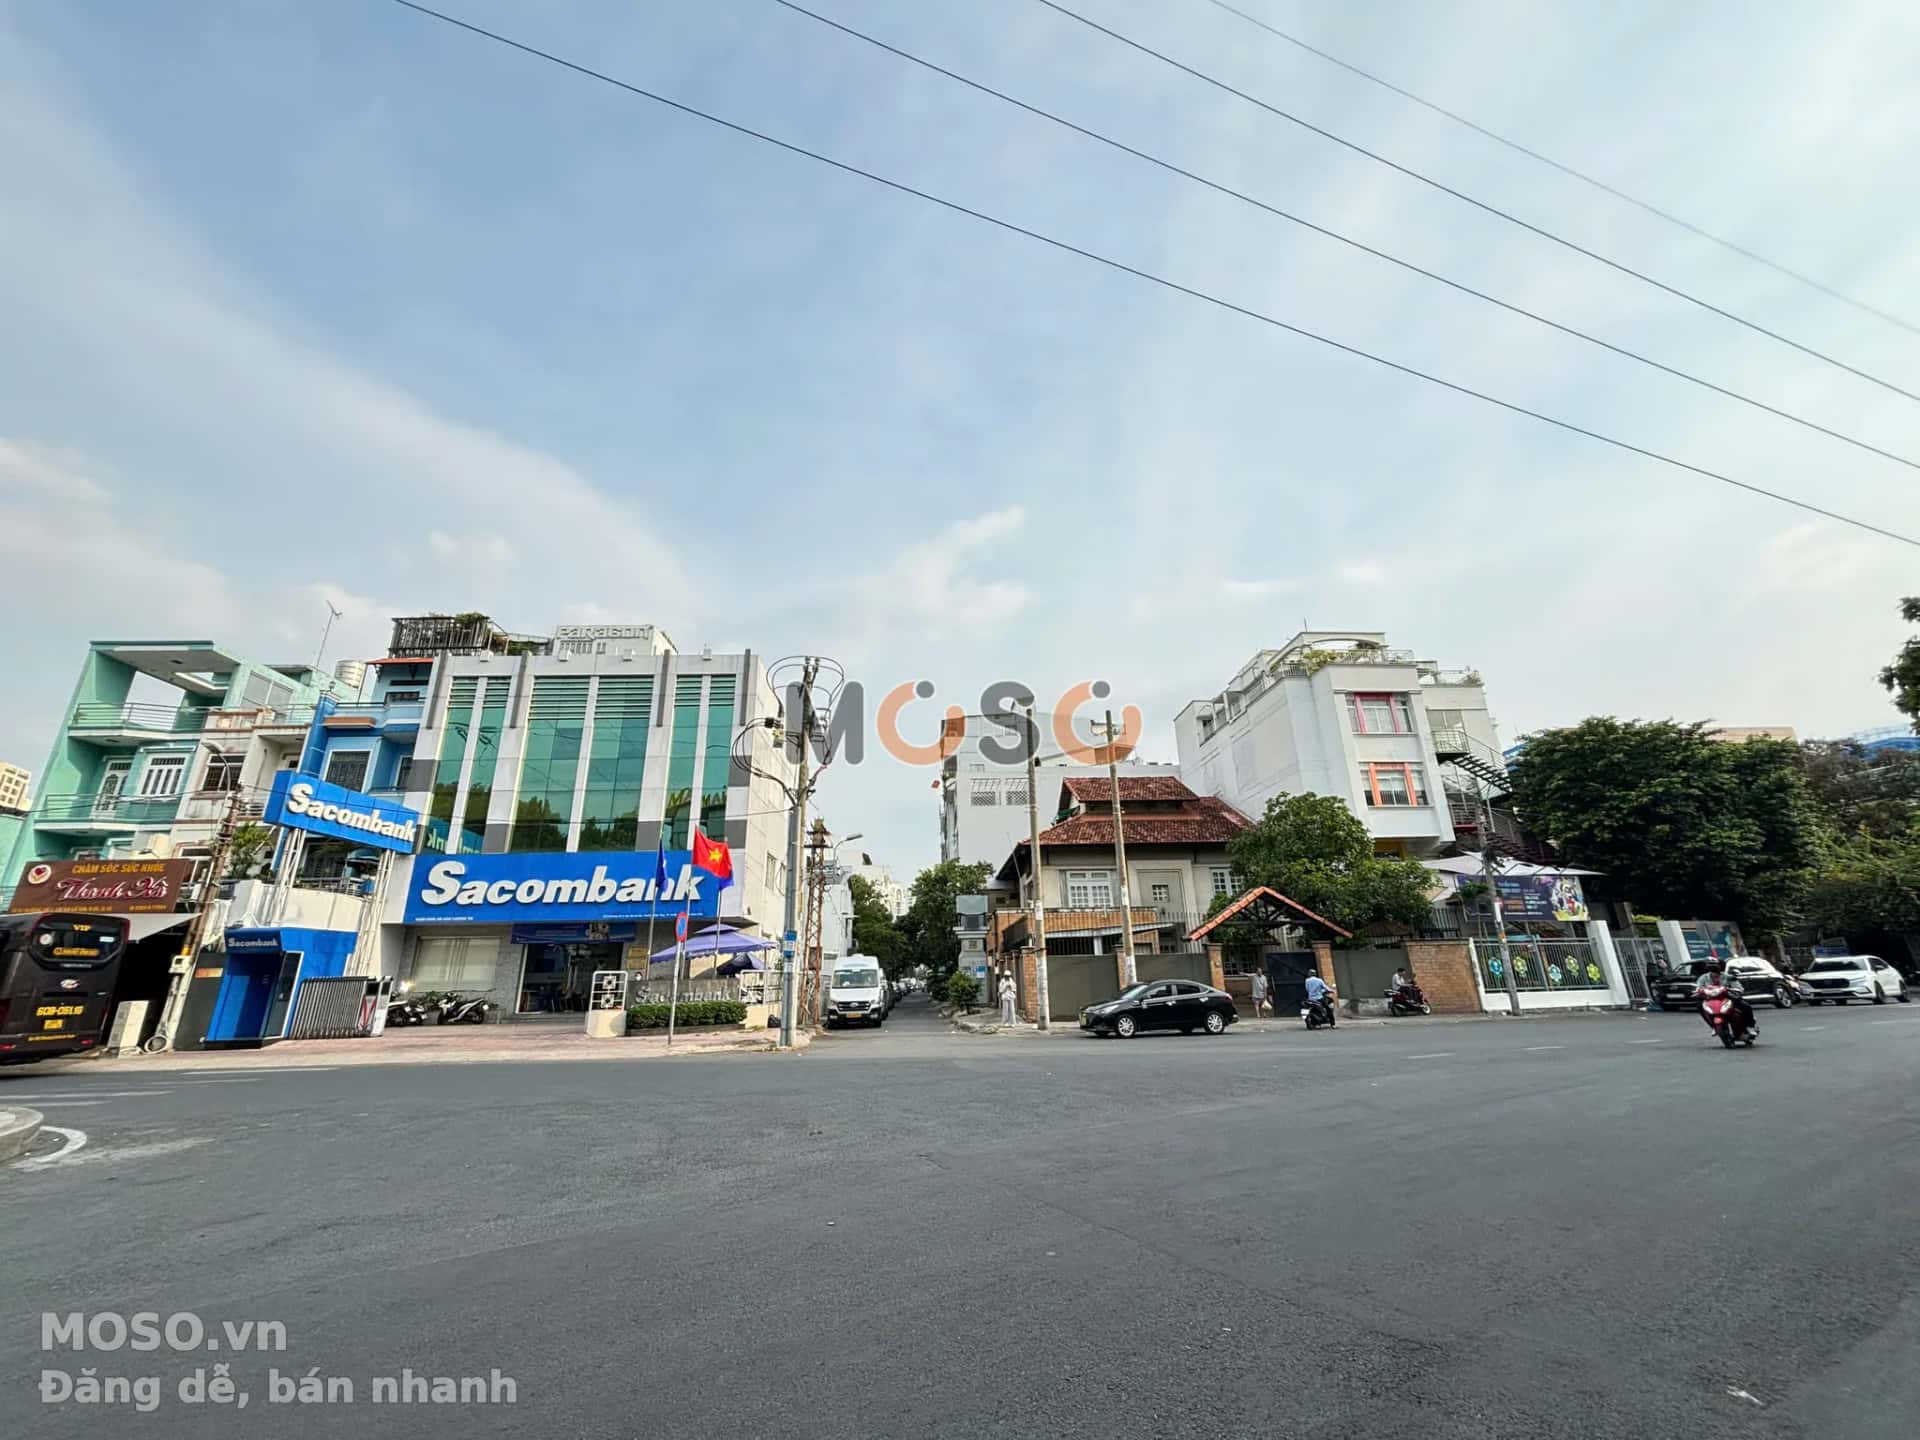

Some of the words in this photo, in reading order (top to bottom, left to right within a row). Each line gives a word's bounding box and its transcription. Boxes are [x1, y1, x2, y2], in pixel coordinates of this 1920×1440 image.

[287, 783, 416, 842] Sacombank
[421, 860, 705, 906] Sacombank
[72, 923, 92, 932] VIP
